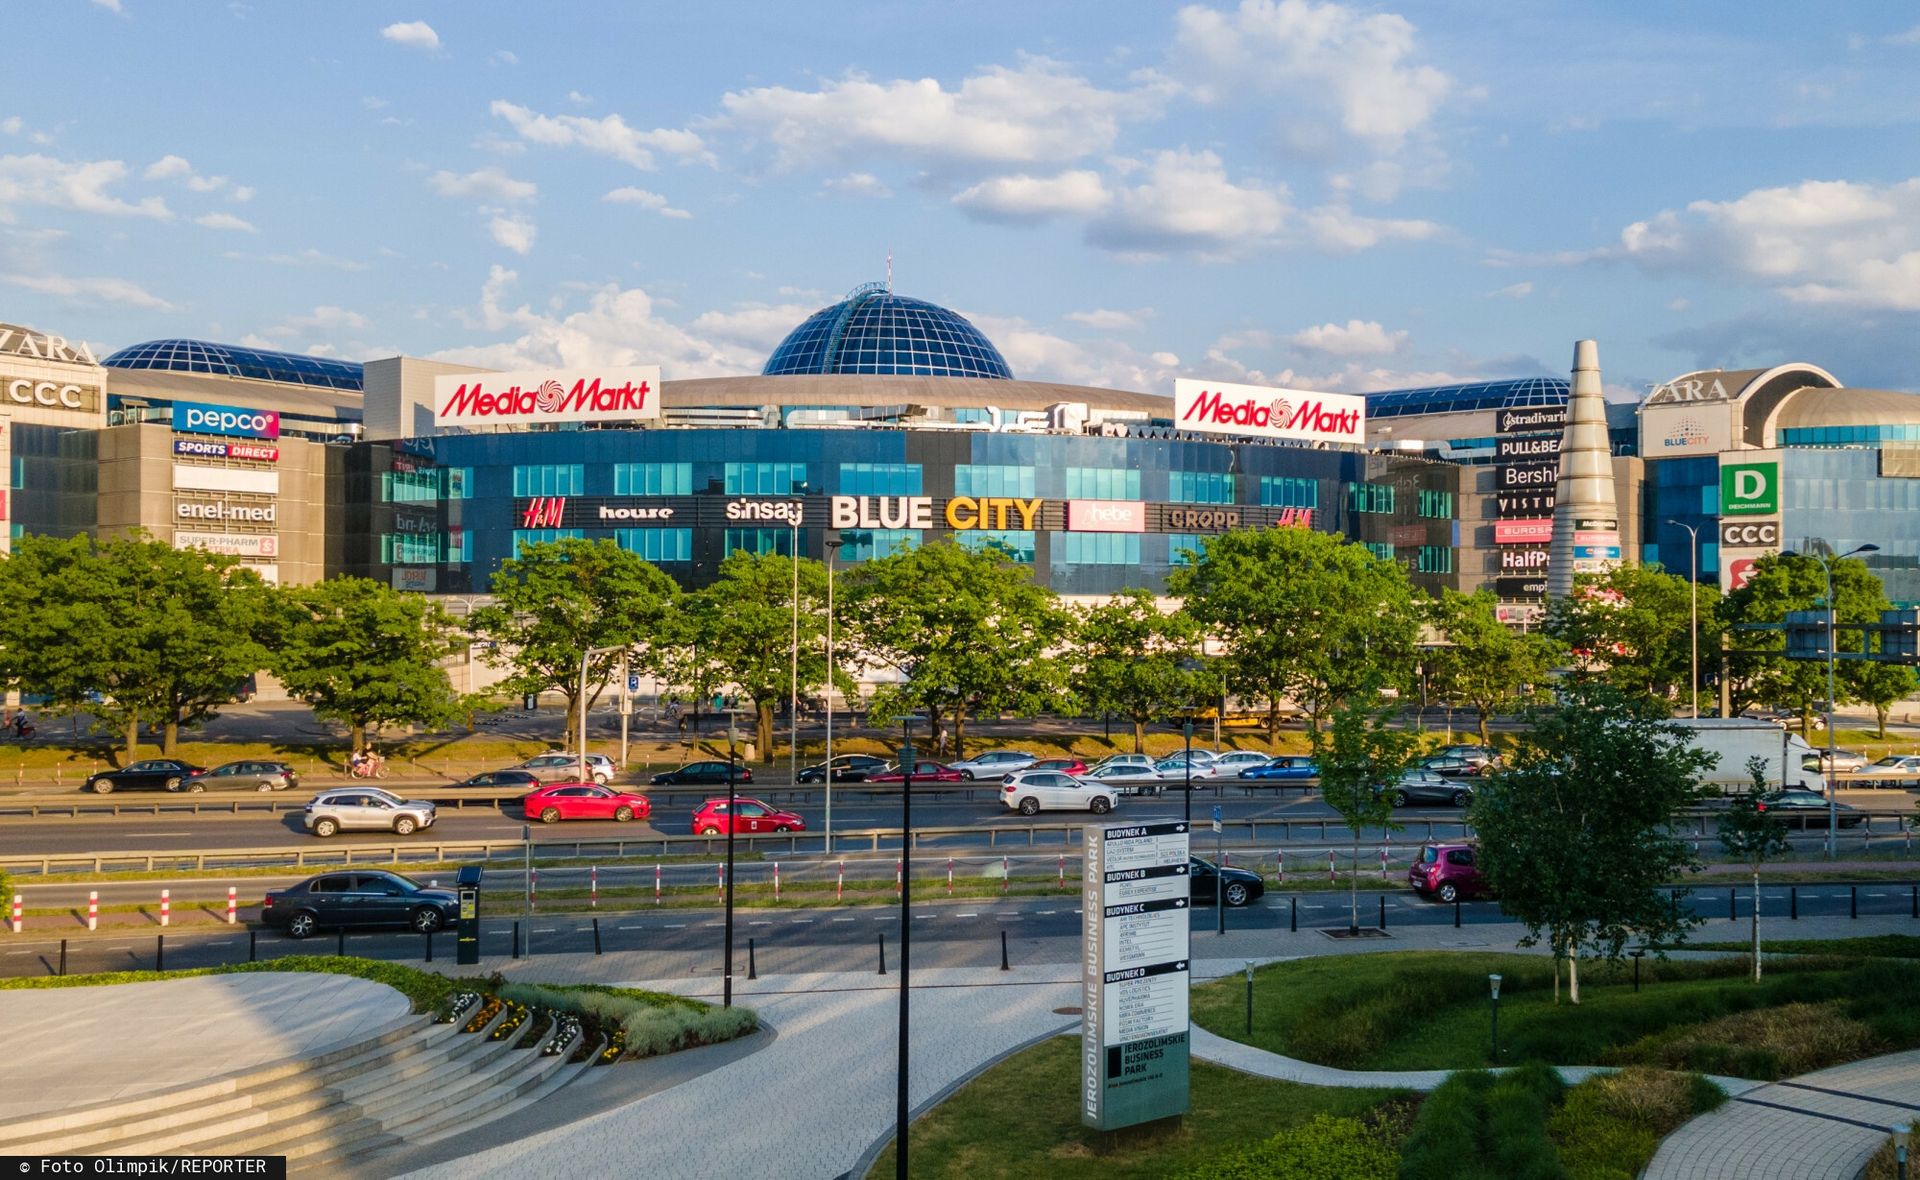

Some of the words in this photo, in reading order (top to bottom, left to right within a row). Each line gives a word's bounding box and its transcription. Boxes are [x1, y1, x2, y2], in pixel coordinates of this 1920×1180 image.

[9, 379, 82, 408] CCC
[440, 383, 539, 417] Media
[557, 378, 650, 412] Markt
[1645, 378, 1728, 404] ZARA
[186, 407, 267, 431] pepco
[1183, 390, 1270, 427] Media
[1287, 400, 1360, 434] Markt
[179, 441, 226, 456] SPORTS
[231, 446, 276, 460] DIRECT
[1735, 470, 1766, 499] D
[177, 501, 276, 522] enel-med
[523, 497, 566, 528] H&M
[600, 506, 674, 519] house
[726, 498, 803, 526] sinsay
[832, 496, 932, 529] BLUE
[945, 497, 1043, 530] CITY
[1091, 503, 1132, 521] hebe
[1724, 525, 1776, 544] CCC
[1107, 828, 1140, 839] BUDYNEK
[1141, 827, 1147, 835] A
[1088, 836, 1098, 884] PARK
[1107, 870, 1140, 881] BUDYNEK
[1140, 869, 1146, 878] B
[1106, 904, 1140, 916] BUDYNEK
[1140, 904, 1145, 912] C
[1088, 890, 1098, 976] BUSINESS
[1106, 970, 1138, 982] BUDYNEK
[1140, 968, 1145, 976] D
[1087, 982, 1097, 1120] JEROZOLIMSKIE
[1124, 1049, 1164, 1065] BUSINESS
[1124, 1063, 1147, 1075] PARK
